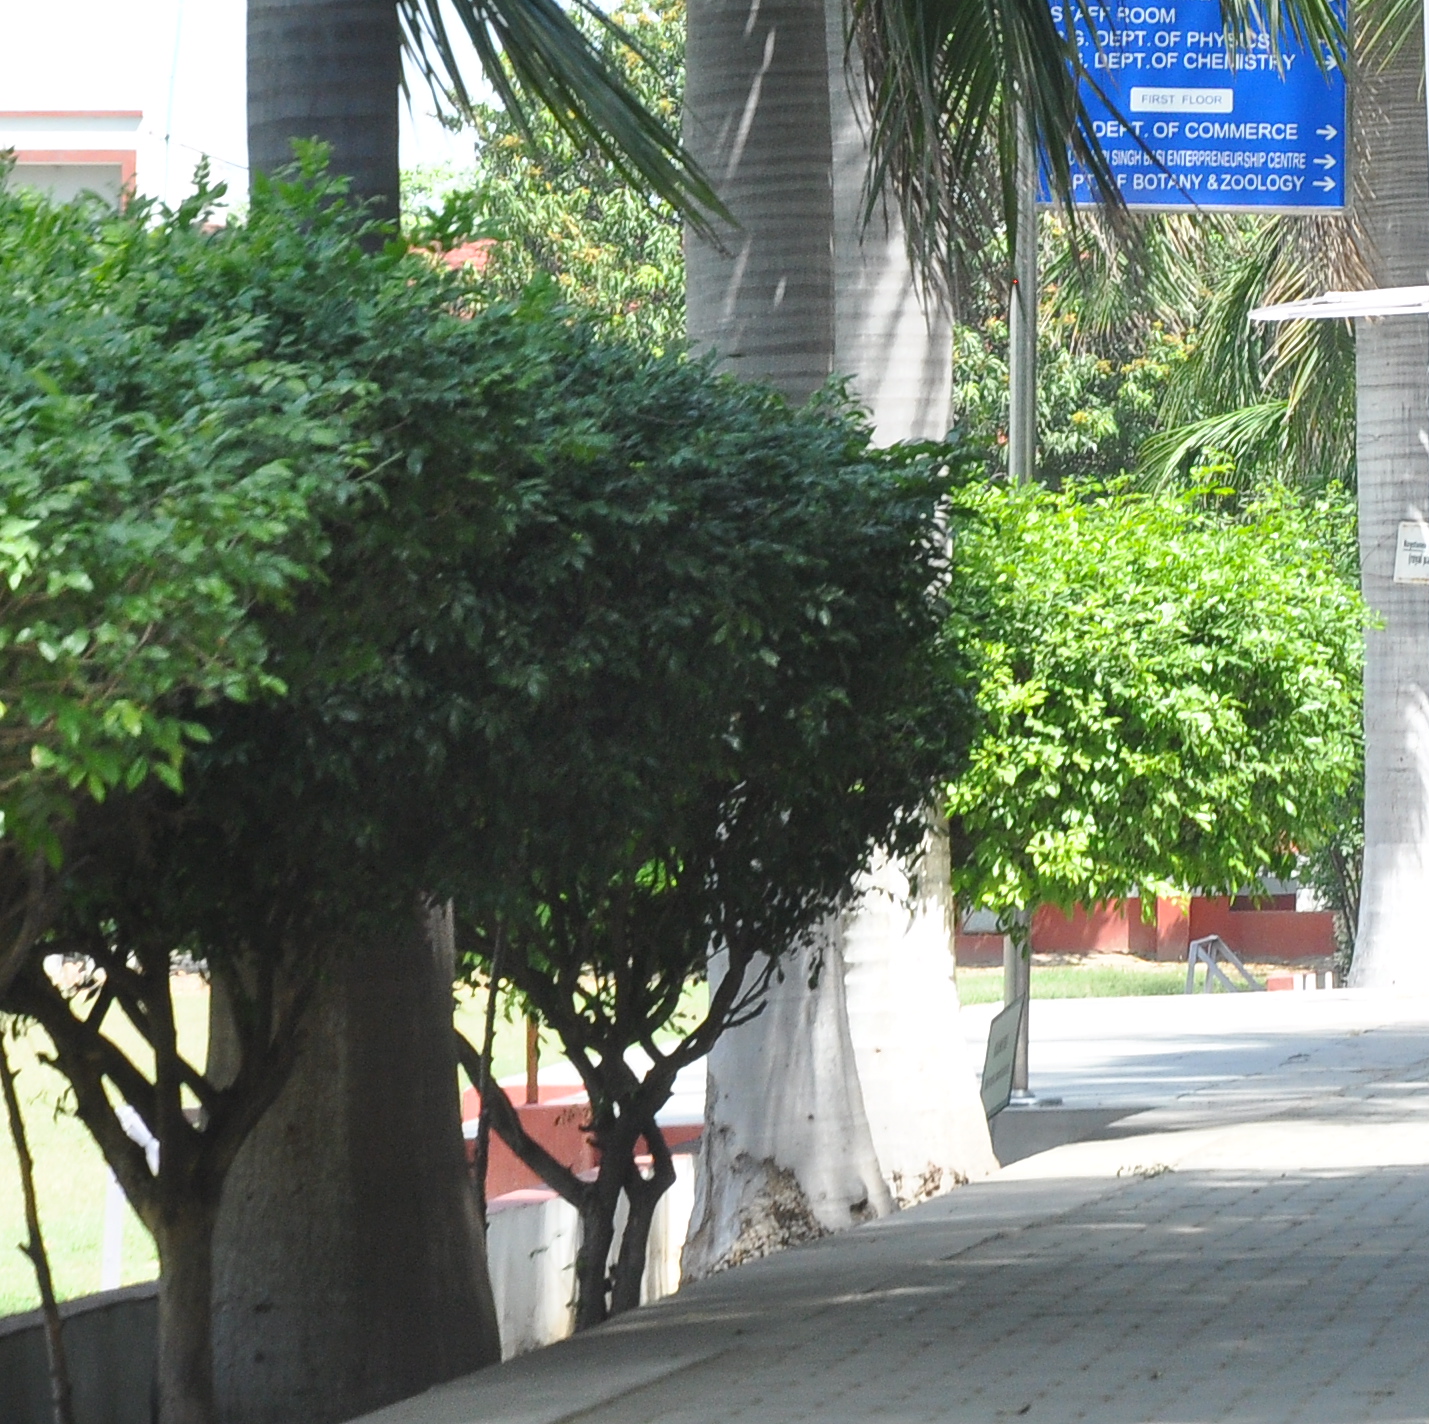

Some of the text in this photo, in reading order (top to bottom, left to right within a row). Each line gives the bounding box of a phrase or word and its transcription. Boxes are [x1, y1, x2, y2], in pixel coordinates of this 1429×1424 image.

[1051, 6, 1176, 24] SAFF ROOM
[1096, 30, 1150, 47] DEPT.
[1154, 31, 1181, 47] OF
[1094, 52, 1150, 69] DEPT.
[1151, 52, 1178, 69] OF
[1183, 53, 1296, 71] CHEMISTRY
[1141, 94, 1223, 105] FIRST FLOOR
[1092, 120, 1148, 138] DEPT.
[1153, 122, 1179, 138] OF
[1185, 122, 1299, 140] COMMERCE
[1111, 149, 1142, 166] SINGH
[1143, 149, 1166, 166] BSI
[1268, 152, 1307, 169] CENTRE
[1133, 174, 1204, 190] BOTANY
[1207, 174, 1219, 190] &
[1220, 174, 1305, 191] ZOOLOGY
